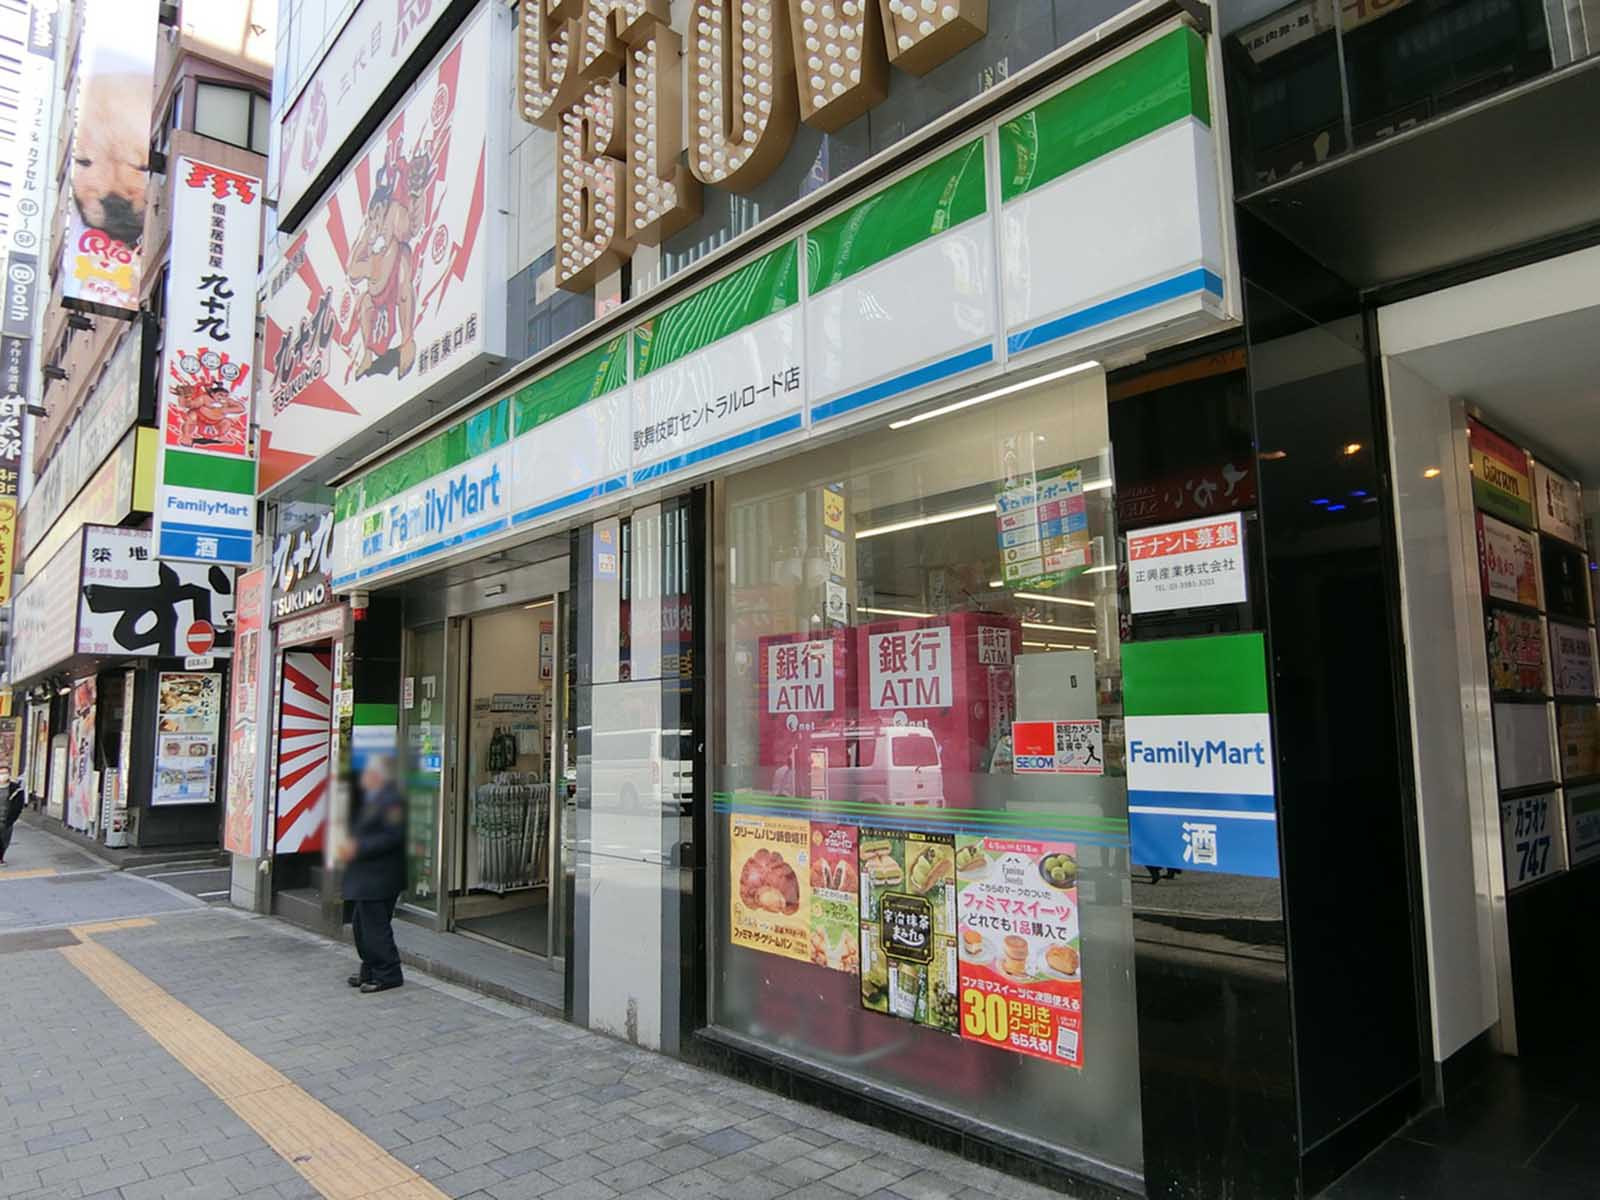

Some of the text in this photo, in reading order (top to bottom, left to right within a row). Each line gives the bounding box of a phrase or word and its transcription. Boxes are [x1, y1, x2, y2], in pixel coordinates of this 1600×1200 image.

[192, 273, 235, 342] 九十九
[633, 365, 800, 451] 歌舞伎町セントラルロード店
[167, 496, 248, 517] FamilyMart
[195, 536, 219, 558] 酒
[1130, 524, 1236, 558] テナント募集
[273, 583, 325, 617] TSUKUMO
[776, 643, 825, 681] 銀行
[878, 632, 941, 674] 銀行
[775, 683, 825, 711] ATM
[880, 676, 941, 708] ATM
[1016, 757, 1055, 769] SECOM
[1130, 740, 1265, 768] FamilyMart
[1182, 821, 1218, 866] 酒
[1516, 836, 1551, 882] 747
[963, 892, 1071, 921] ファミマスイーツ
[967, 912, 1068, 941] どれでも1品購入で
[963, 988, 1009, 1041] 30
[1010, 1017, 1052, 1038] クーポン
